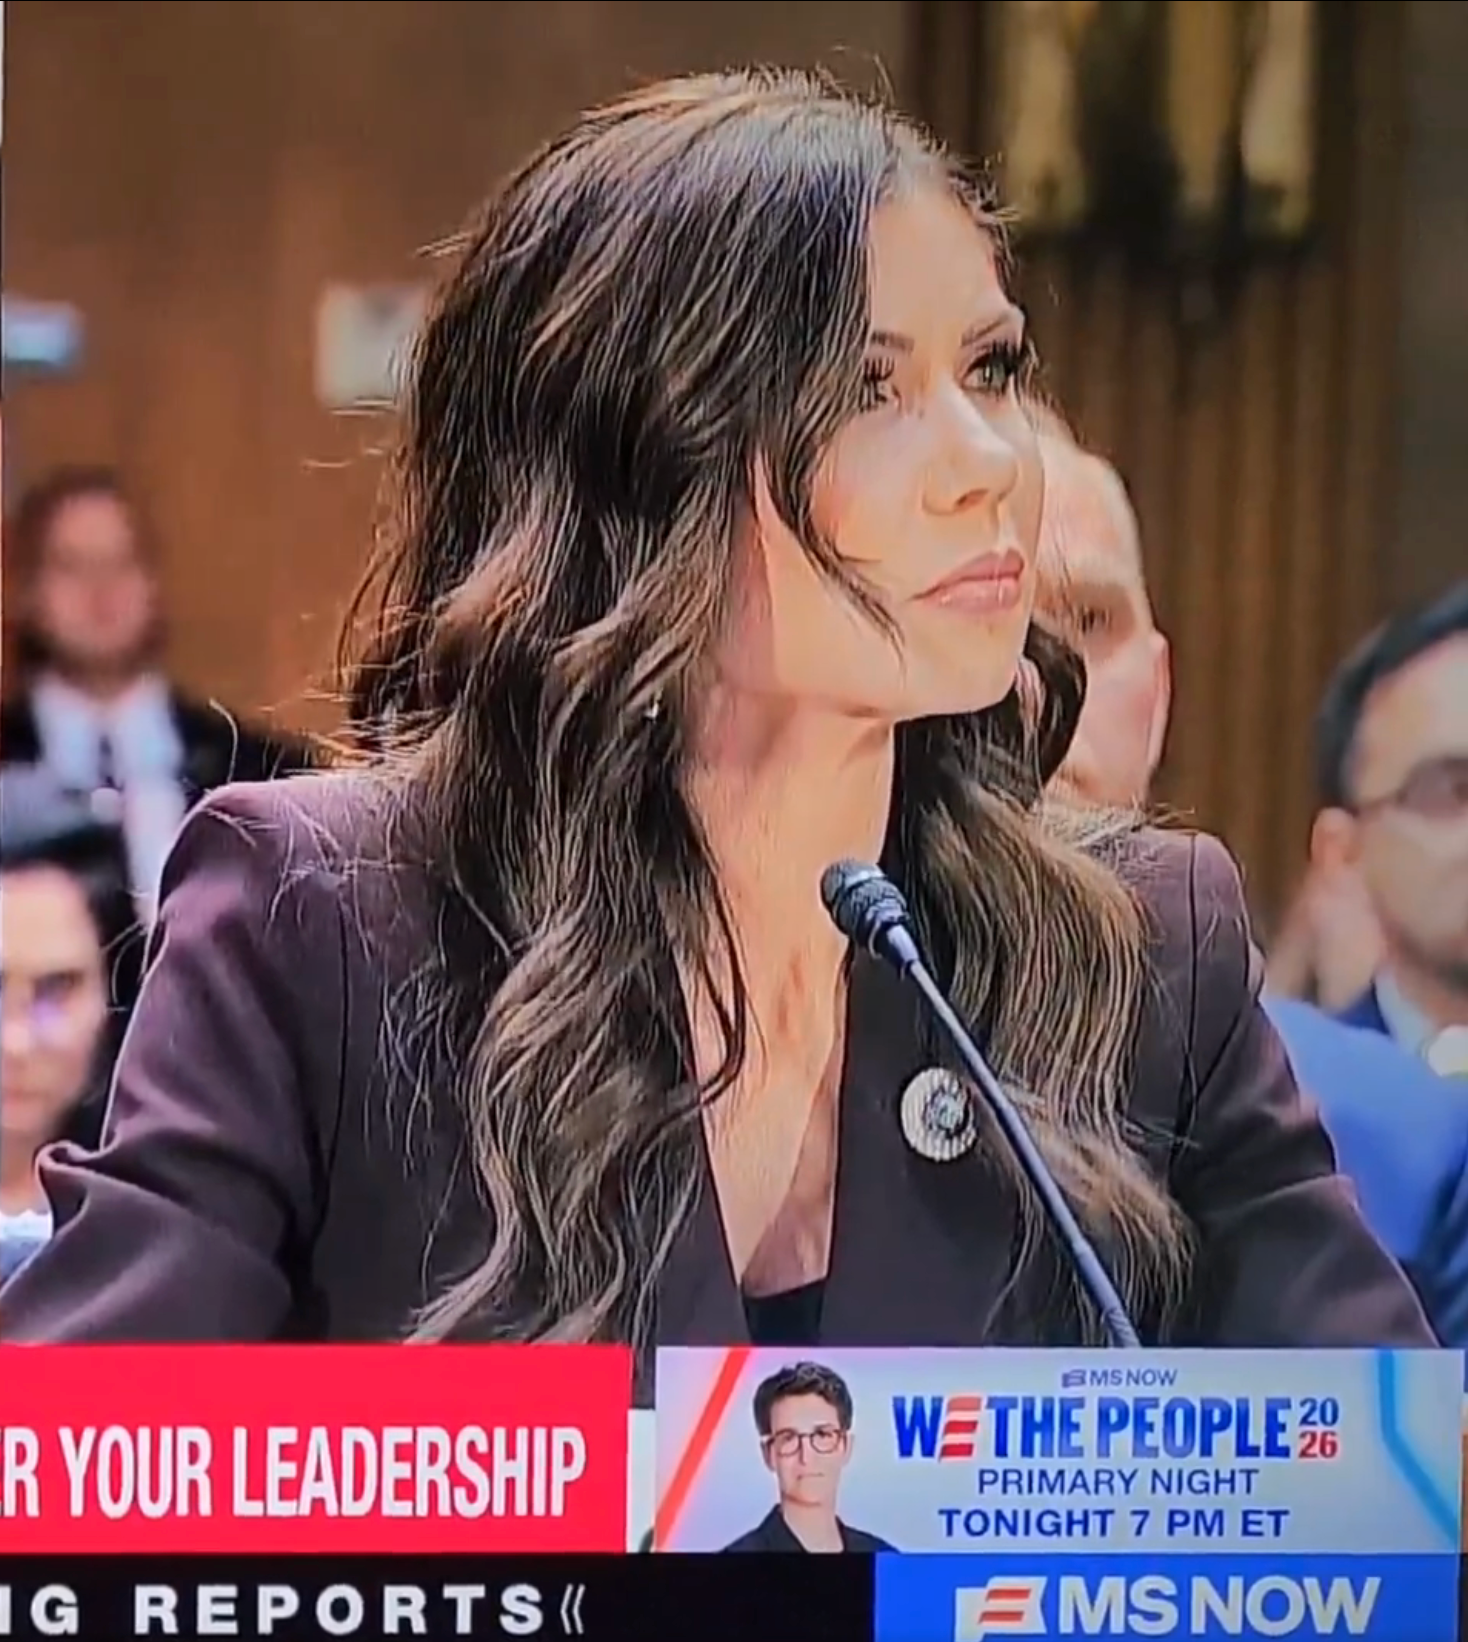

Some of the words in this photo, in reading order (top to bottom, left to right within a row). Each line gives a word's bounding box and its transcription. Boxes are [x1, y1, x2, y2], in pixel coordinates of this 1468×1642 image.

[1299, 1398, 1339, 1427] 20
[892, 1396, 983, 1463] WE
[986, 1396, 1085, 1458] THE
[1097, 1396, 1292, 1458] PEOPLE
[1299, 1431, 1338, 1459] 26
[58, 1425, 212, 1519] YOUR
[234, 1425, 586, 1518] LEADERSHIP
[978, 1469, 1138, 1495] PRIMARY
[1151, 1469, 1259, 1495] NIGHT
[938, 1509, 1114, 1538] TONIGHT
[1131, 1510, 1150, 1537] 7
[1167, 1509, 1224, 1537] PM
[1242, 1509, 1290, 1537] ET
[135, 1584, 543, 1635] REPORTS
